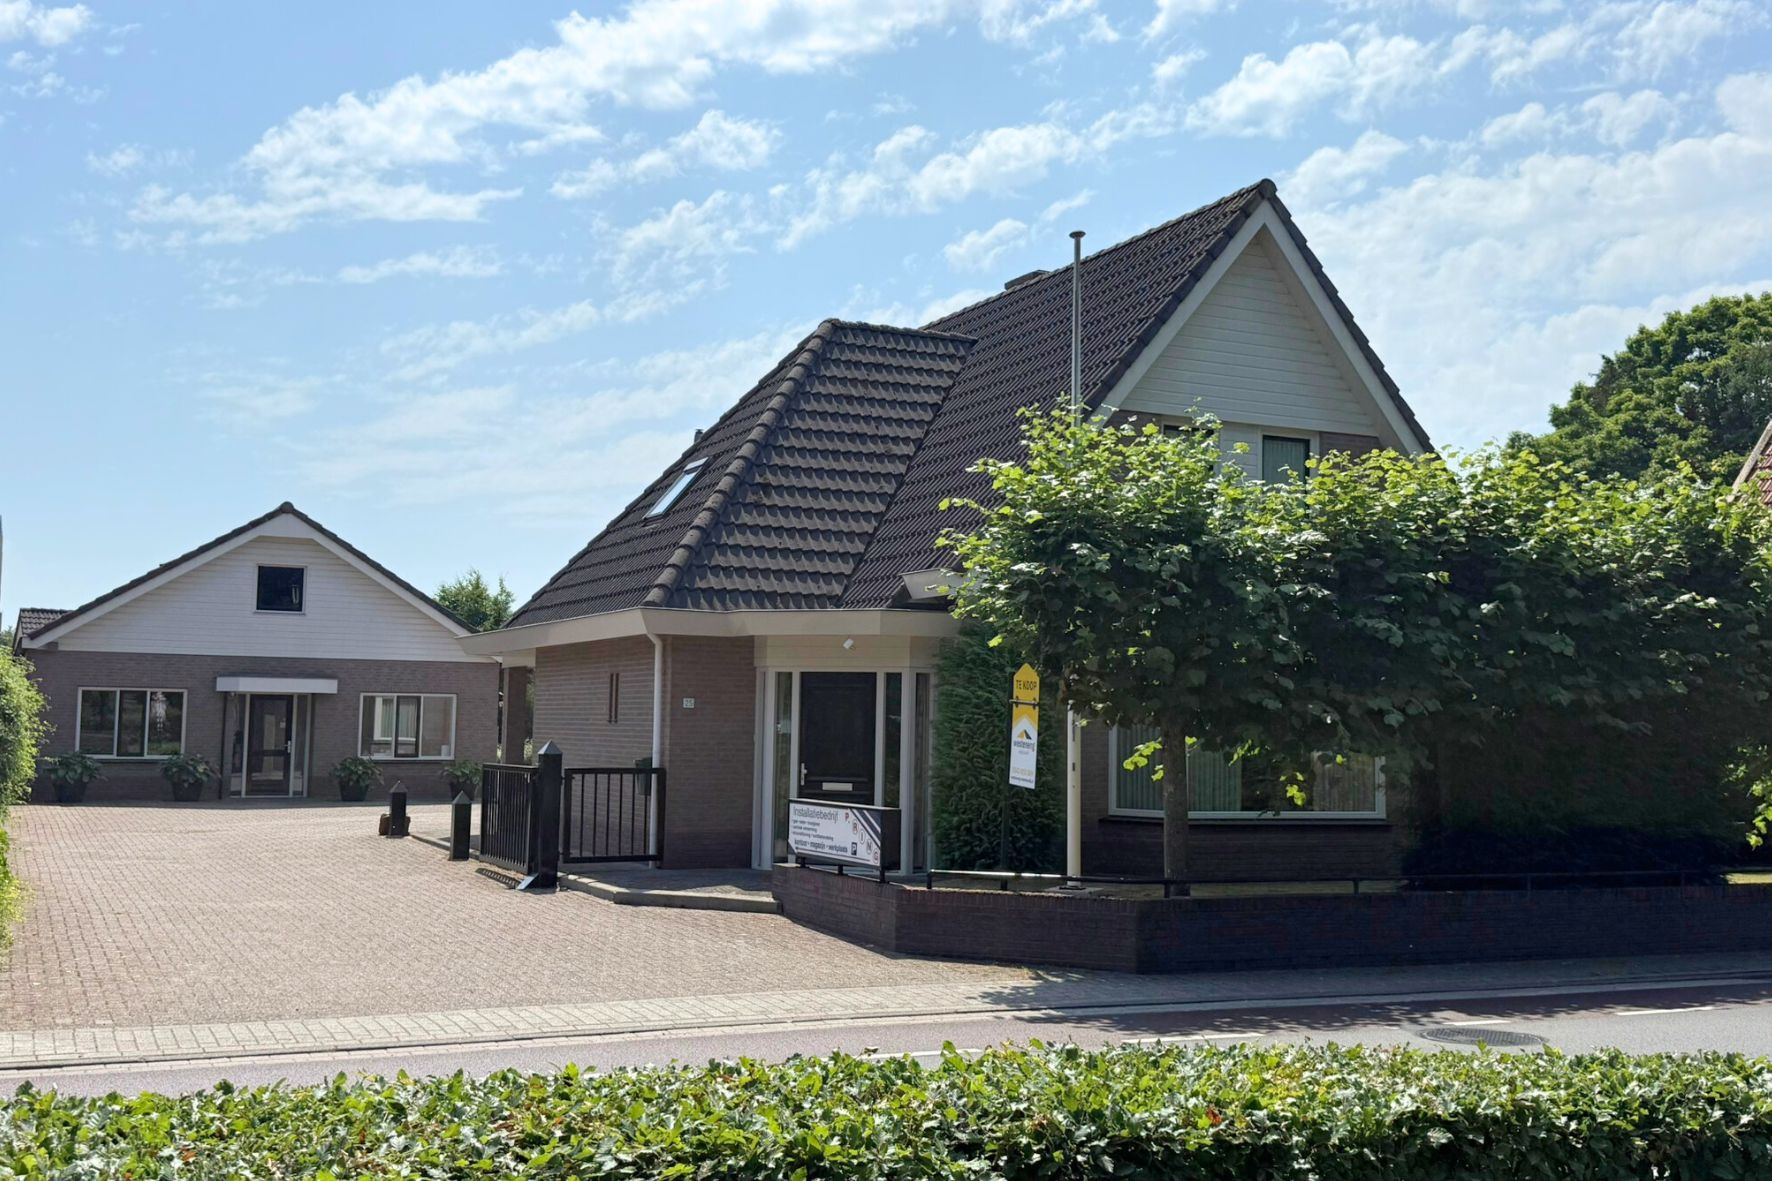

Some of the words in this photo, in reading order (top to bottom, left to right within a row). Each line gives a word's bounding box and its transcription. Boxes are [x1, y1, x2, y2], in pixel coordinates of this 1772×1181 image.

[1016, 679, 1022, 690] TE
[1023, 680, 1037, 691] KOOP
[793, 806, 839, 824] Installatiebedrijf
